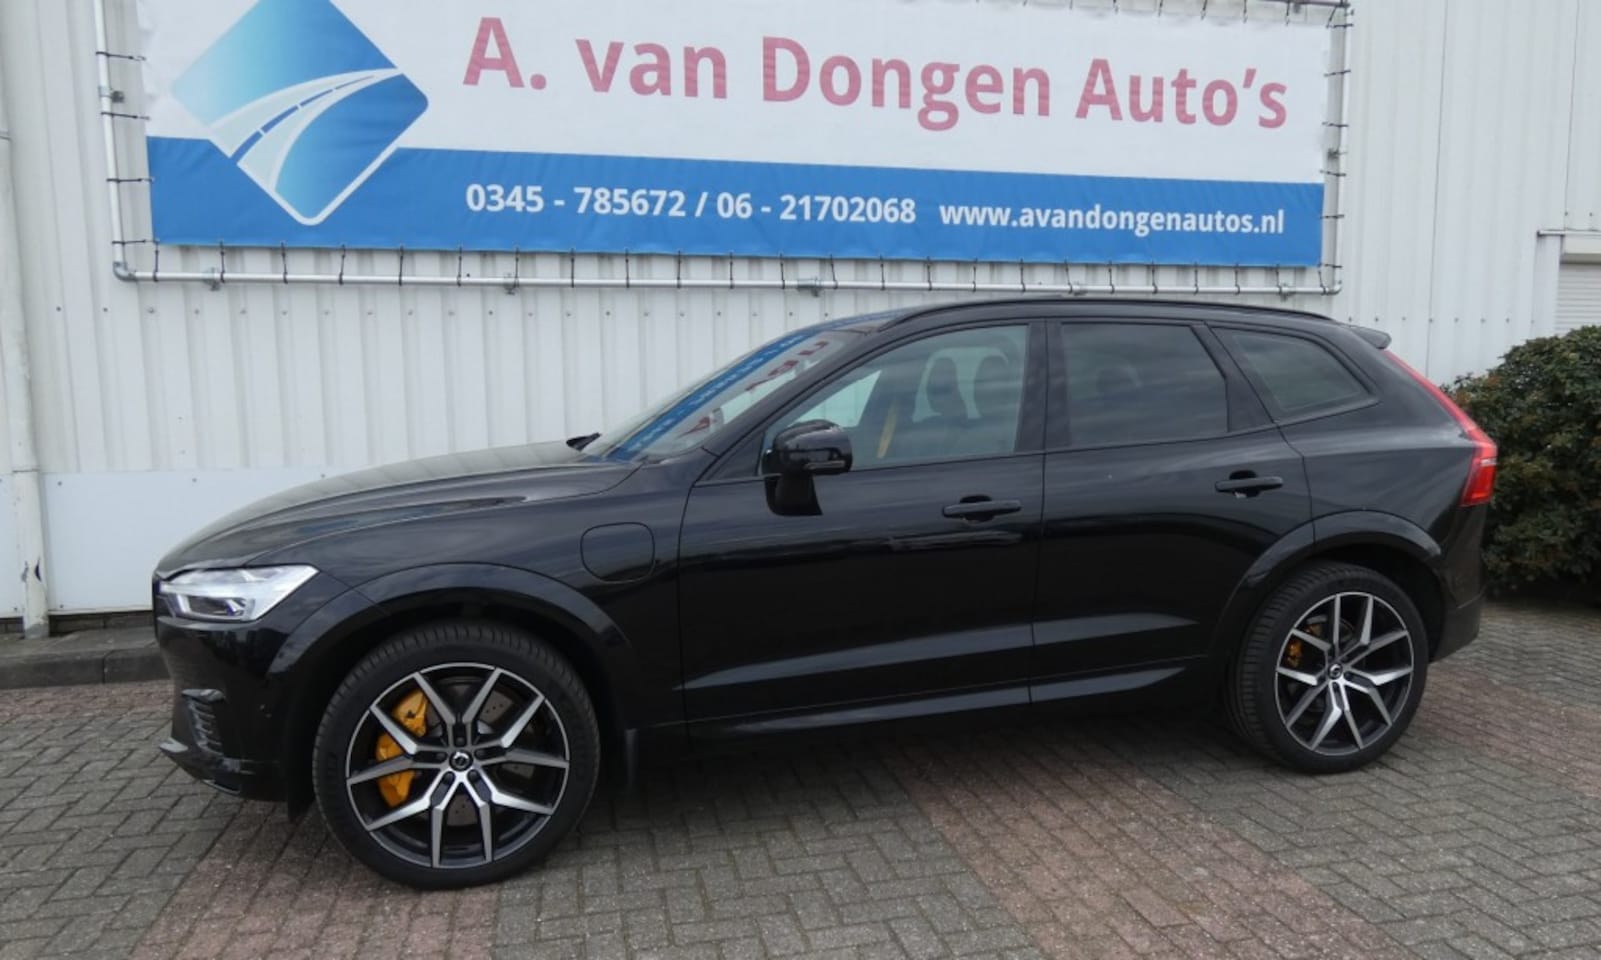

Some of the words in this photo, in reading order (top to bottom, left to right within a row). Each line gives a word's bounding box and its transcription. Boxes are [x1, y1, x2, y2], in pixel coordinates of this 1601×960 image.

[462, 17, 546, 89] A.
[576, 39, 728, 99] van
[762, 36, 1051, 131] Dongen
[465, 183, 545, 212] 0345
[573, 186, 687, 217] 785672
[694, 191, 709, 218] /
[716, 192, 753, 219] 06
[779, 194, 917, 223] 21702068
[938, 203, 1285, 238] www.avandongenautos.nl
